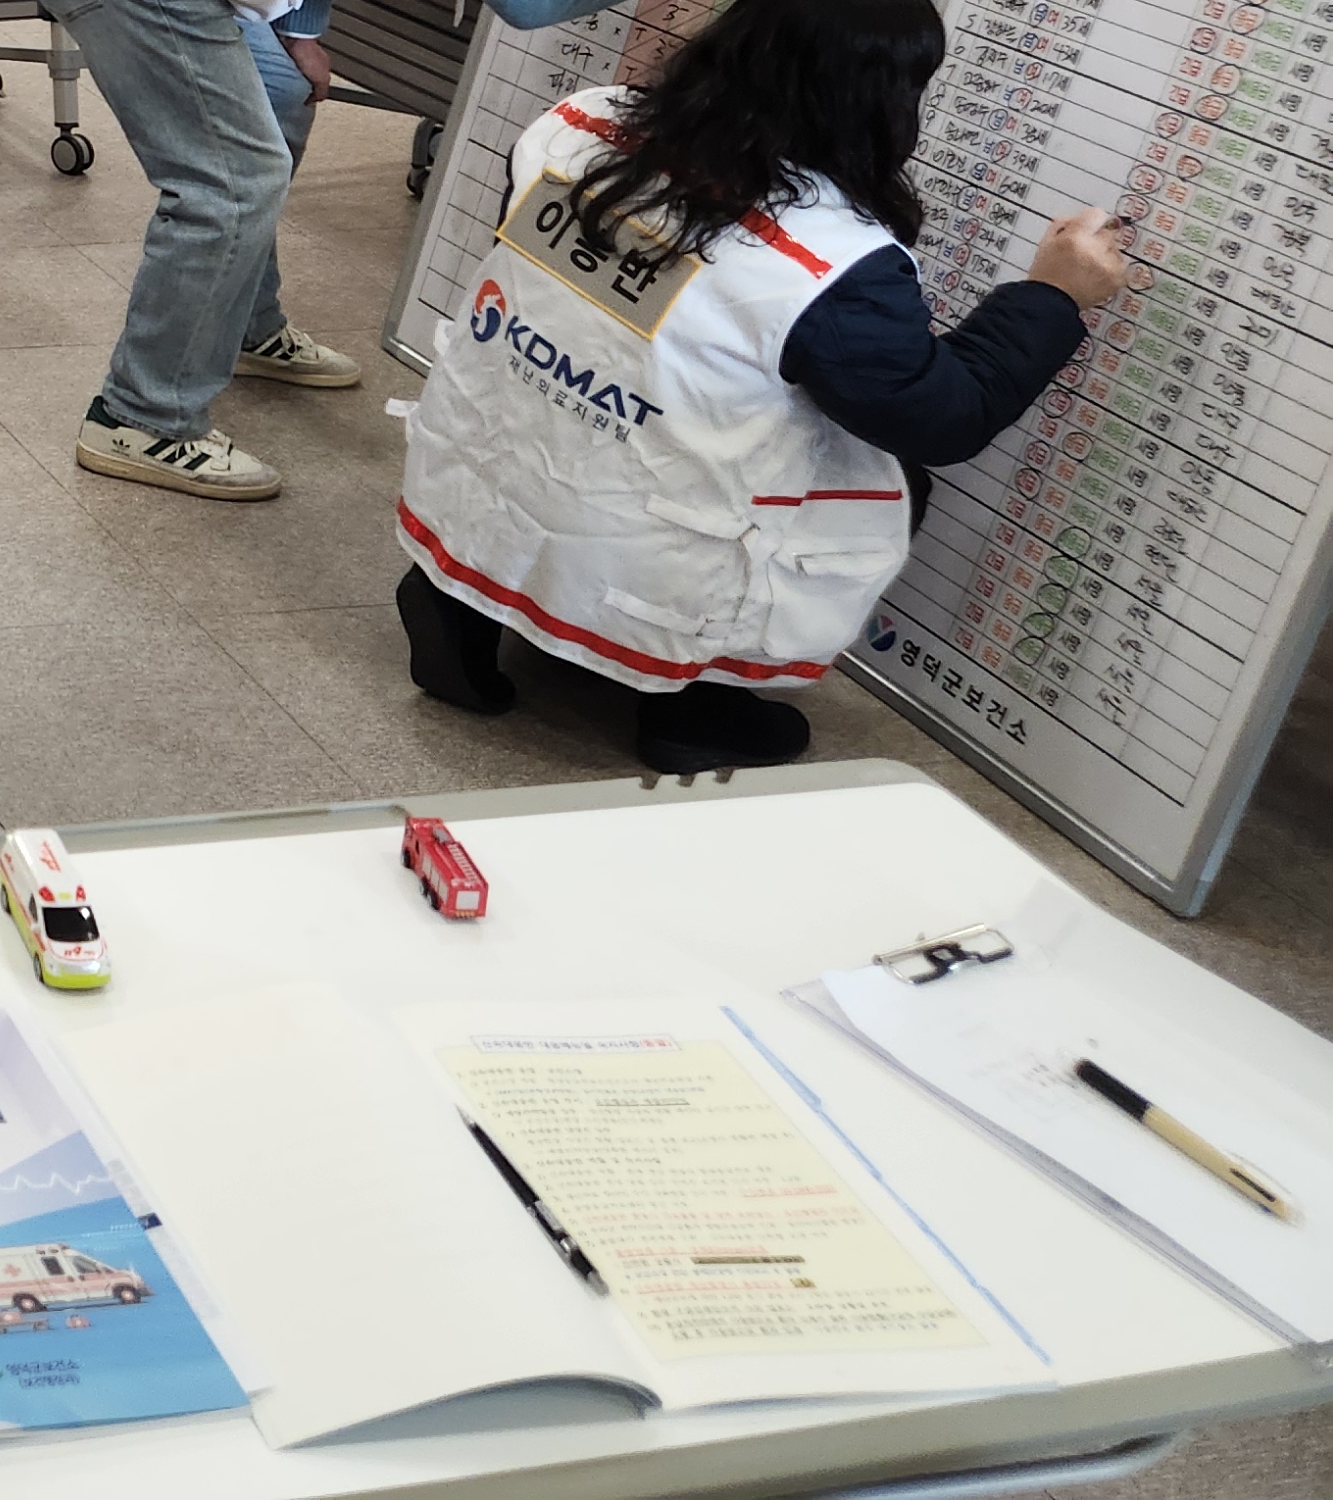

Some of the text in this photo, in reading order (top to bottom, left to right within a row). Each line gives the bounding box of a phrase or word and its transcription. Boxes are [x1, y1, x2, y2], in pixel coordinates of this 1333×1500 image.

[504, 315, 664, 427] KDMAT
[508, 353, 632, 443] 재난의료지원팀
[898, 637, 1029, 748] 영덕군보건소
